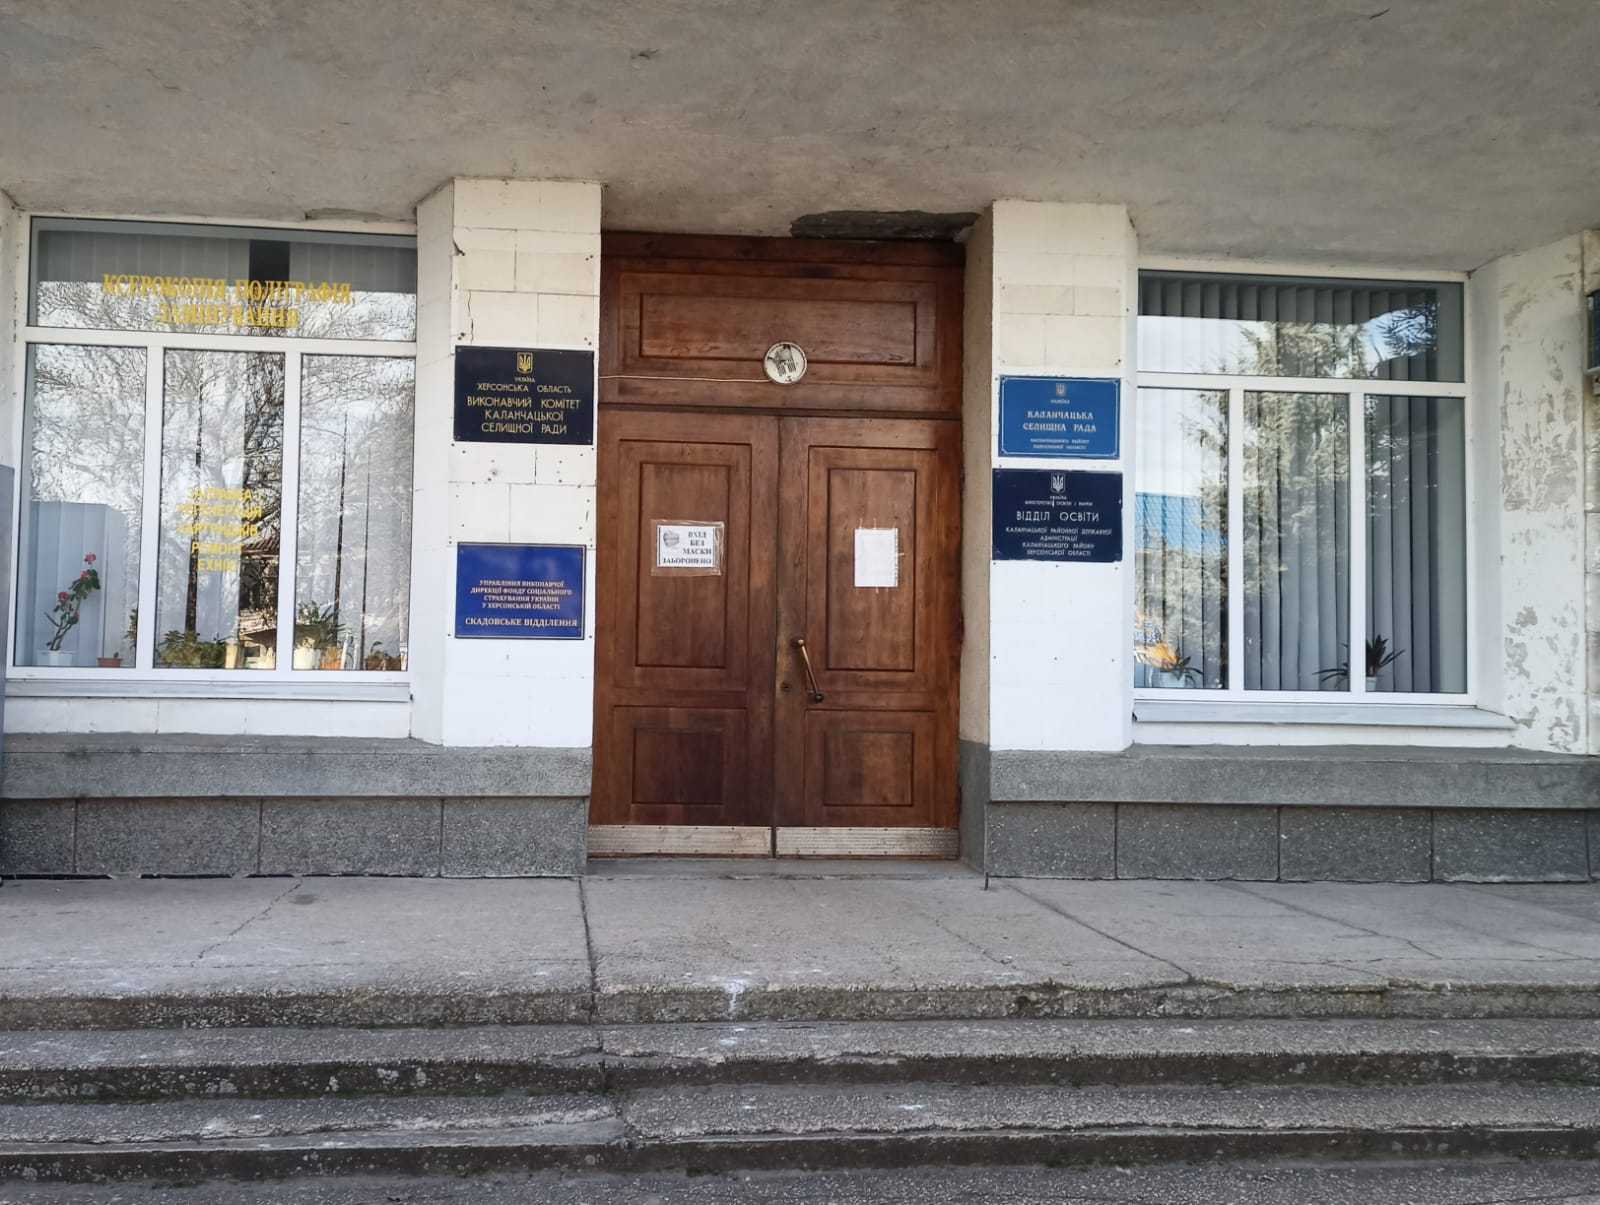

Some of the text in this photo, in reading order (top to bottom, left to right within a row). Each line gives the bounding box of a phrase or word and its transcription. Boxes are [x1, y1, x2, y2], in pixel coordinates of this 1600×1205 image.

[477, 383, 571, 393] ХЕРСОНСЬКА ОБЛАСТЬ
[467, 396, 580, 409] ВИКОНАВЧИЙ КОМІТЕТ
[484, 409, 564, 422] КАЛАНЧАЦЬКОЇ
[1027, 411, 1094, 420] КАЛАНЧАЦЬКА
[481, 421, 568, 435] СЕЛИЩНОЇ РАДИ
[1022, 422, 1097, 432] СЕЛИЩНА РАДА
[1016, 510, 1100, 522] ВІДДІЛ ОСВІТИ
[465, 616, 578, 629] СКАДОВСЬКЕ ВІДДІЛЕННЯ
